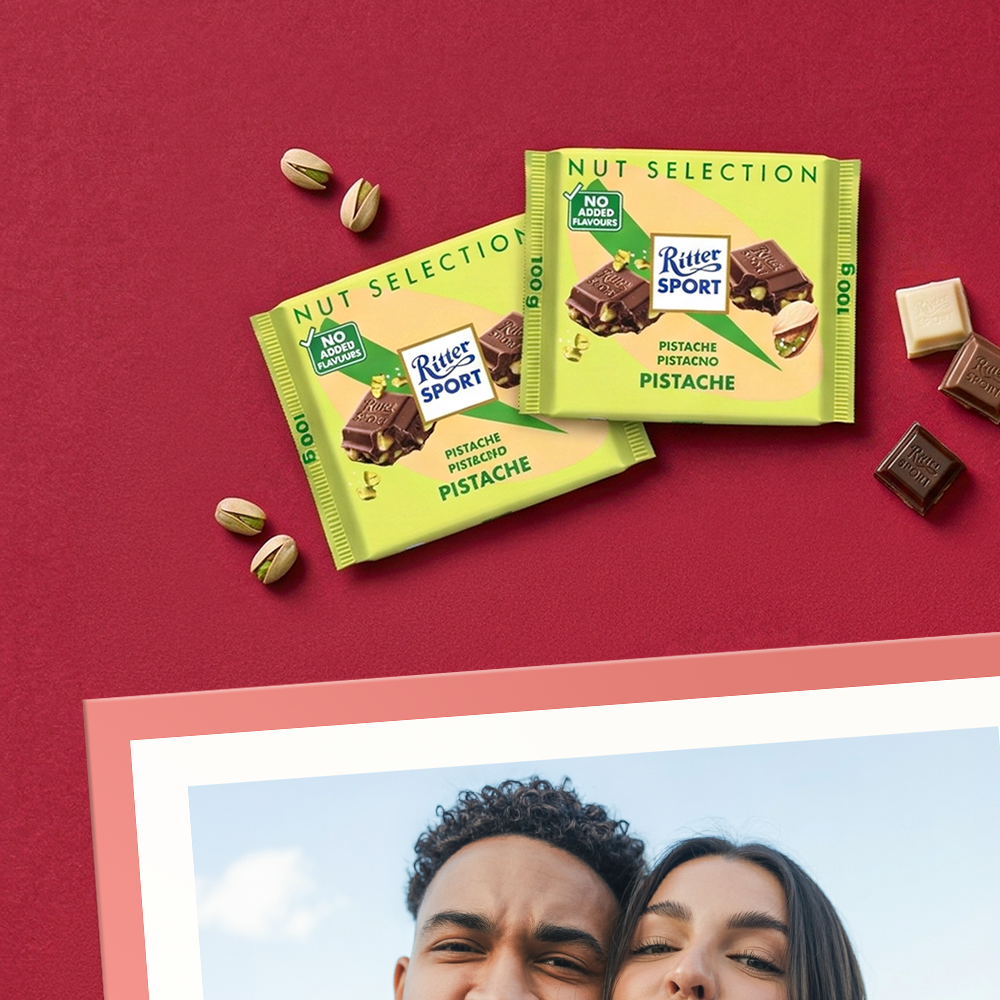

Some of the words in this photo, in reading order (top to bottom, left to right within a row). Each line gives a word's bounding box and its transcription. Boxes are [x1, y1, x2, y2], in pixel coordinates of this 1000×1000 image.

[569, 158, 627, 178] NUT
[647, 160, 817, 183] SELECTION
[584, 195, 609, 208] NO
[572, 218, 618, 227] FLAVOURS
[578, 208, 615, 218] ADDED
[658, 245, 722, 277] Ritter
[657, 278, 721, 295] SPORT
[293, 289, 350, 324] NUT
[321, 330, 346, 347] NO
[658, 340, 717, 353] PISTACHE
[320, 340, 355, 360] ADDED
[411, 339, 476, 386] Ritter
[420, 368, 482, 403] SPORT
[639, 372, 736, 391] PISTACHE
[444, 432, 501, 460] PISTACHE
[437, 455, 532, 502] PISTACHE
